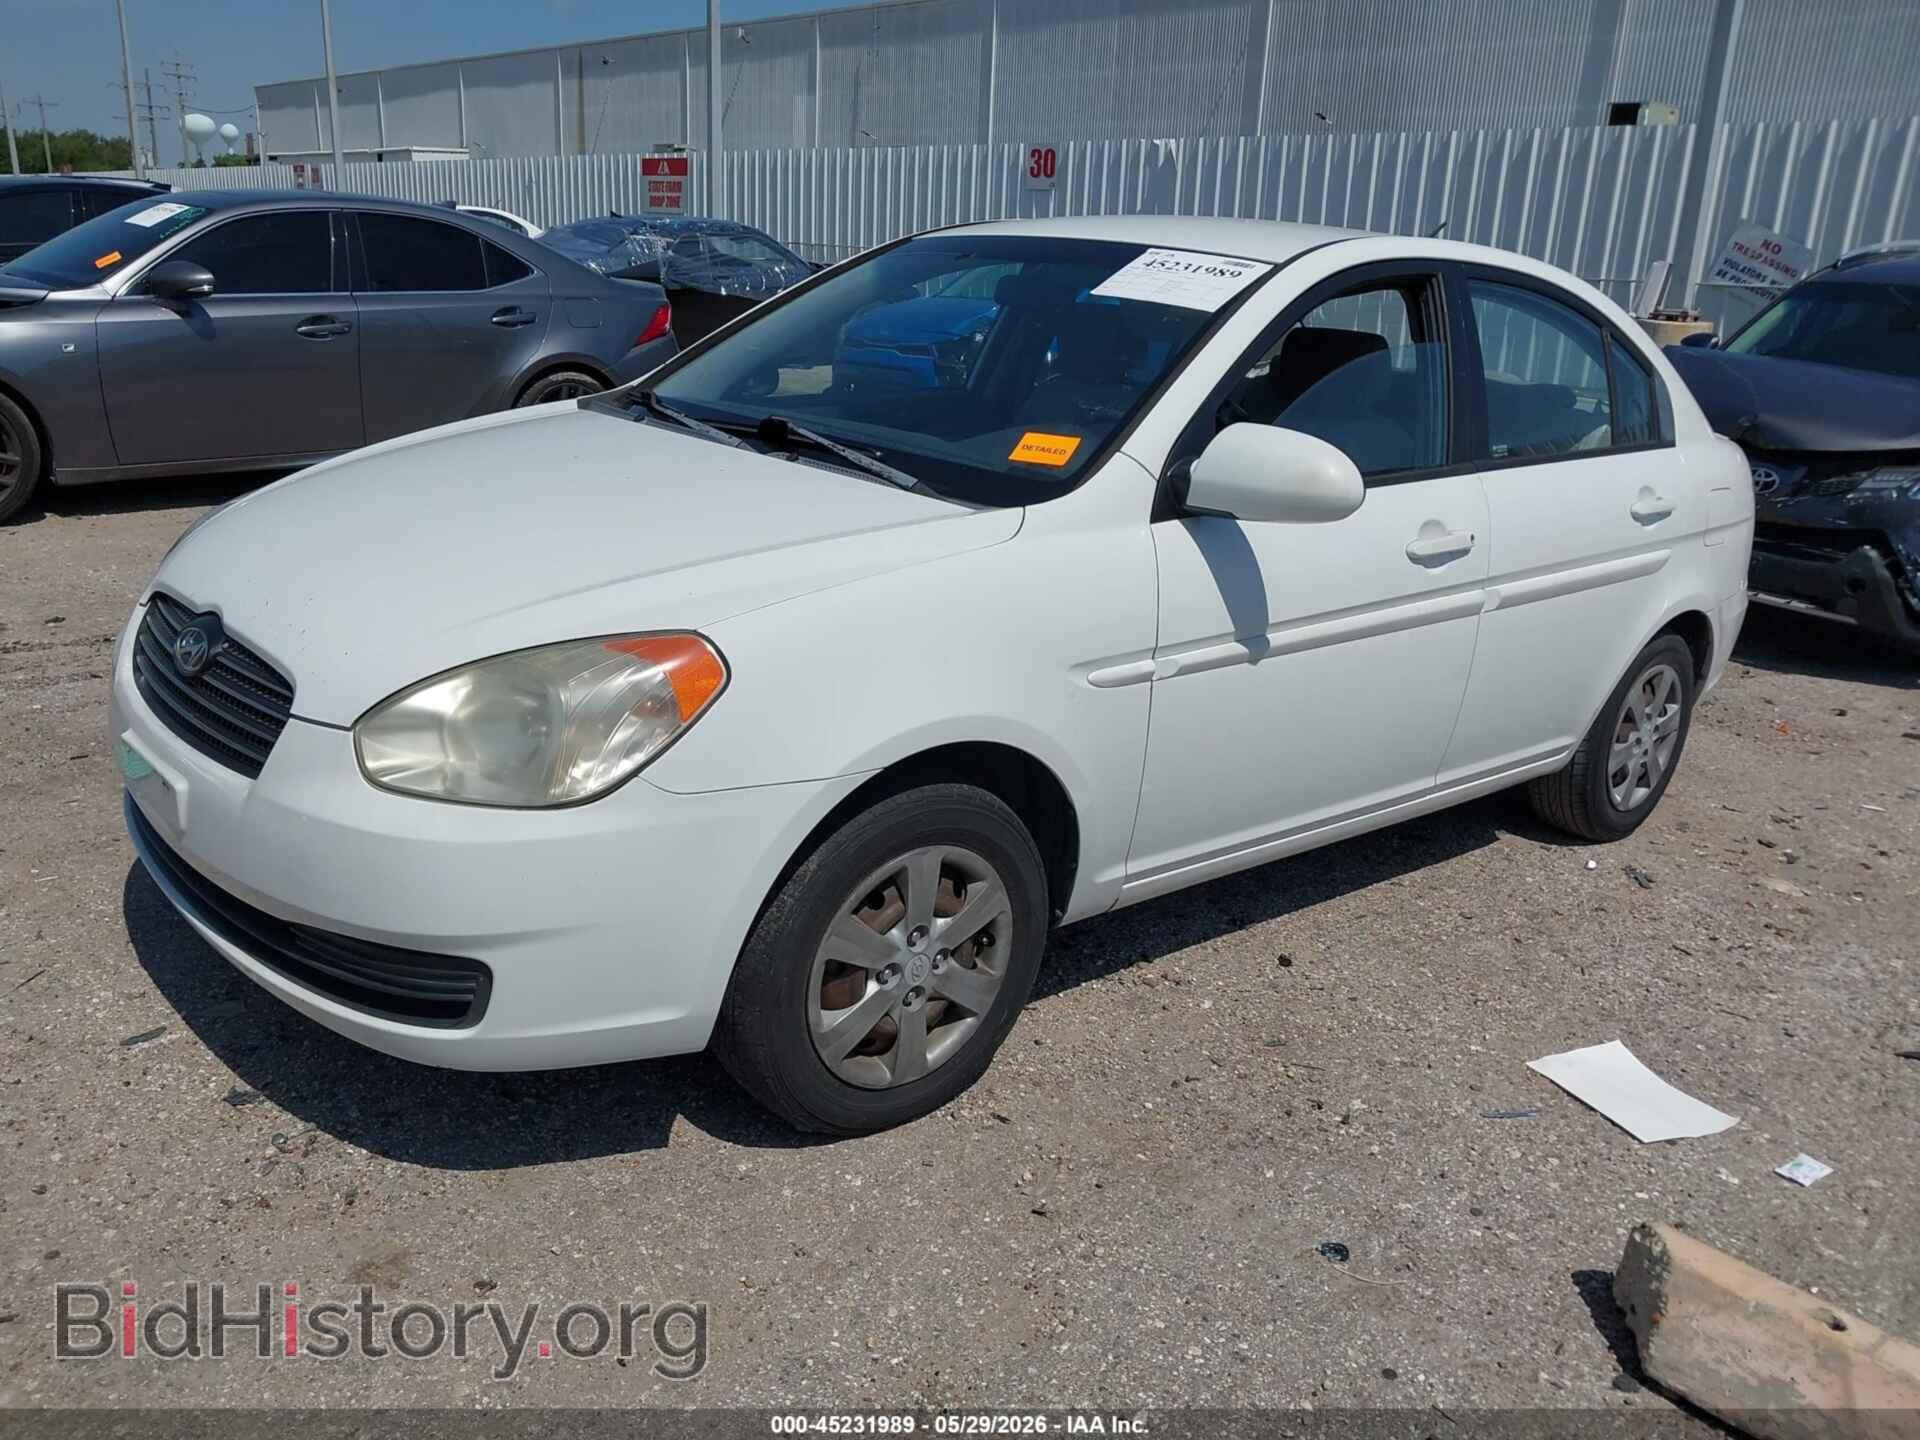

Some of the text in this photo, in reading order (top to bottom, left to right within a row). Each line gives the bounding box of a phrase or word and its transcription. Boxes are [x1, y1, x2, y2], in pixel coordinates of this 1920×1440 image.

[1030, 148, 1056, 178] 30
[1760, 239, 1783, 255] NO
[1142, 258, 1243, 278] 45231989
[1723, 257, 1768, 282] VIOLATORS
[1732, 241, 1798, 278] TRESPASSING
[1021, 444, 1067, 456] DETAILED
